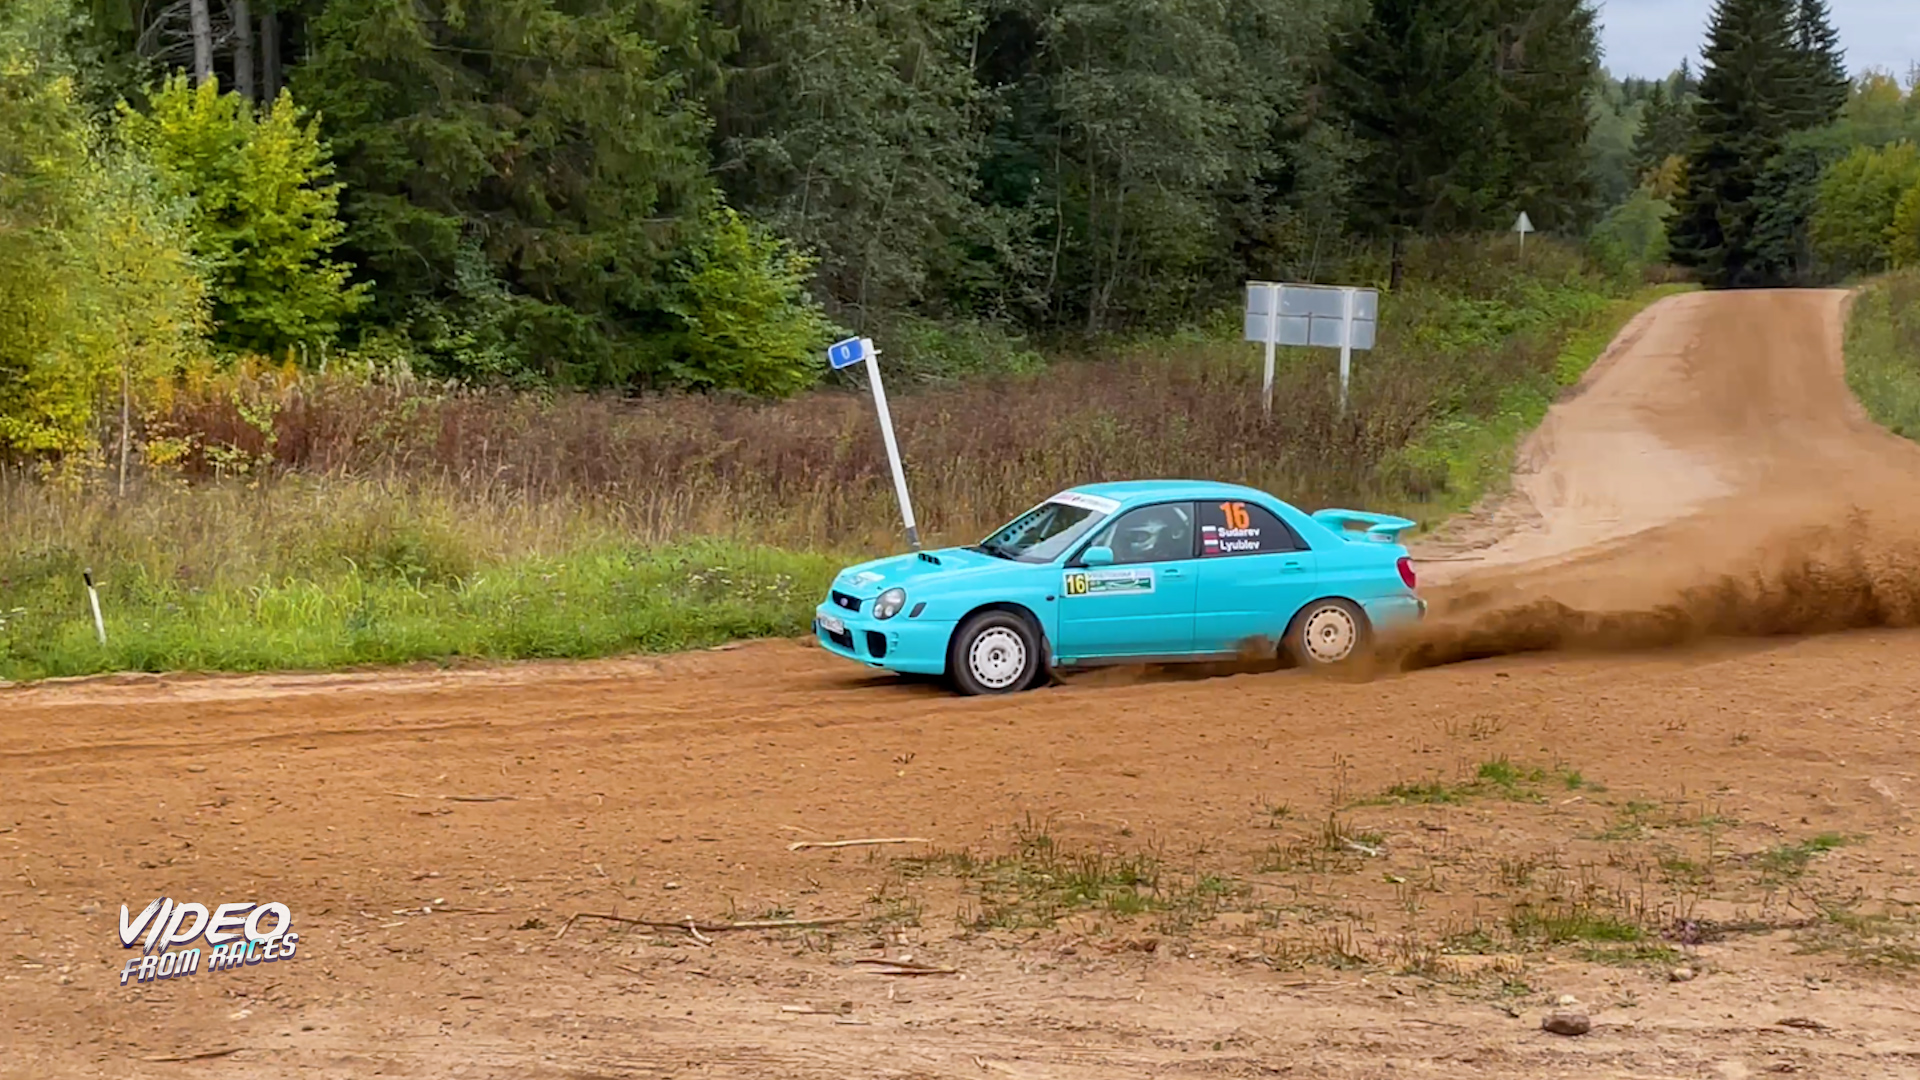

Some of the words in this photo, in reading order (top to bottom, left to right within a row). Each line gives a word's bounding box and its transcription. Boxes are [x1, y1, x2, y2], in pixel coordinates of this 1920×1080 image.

[840, 345, 851, 360] 0
[1219, 501, 1250, 529] 16
[1218, 527, 1261, 538] Sudarev
[1219, 539, 1261, 552] Lyublev
[1067, 573, 1086, 594] 16
